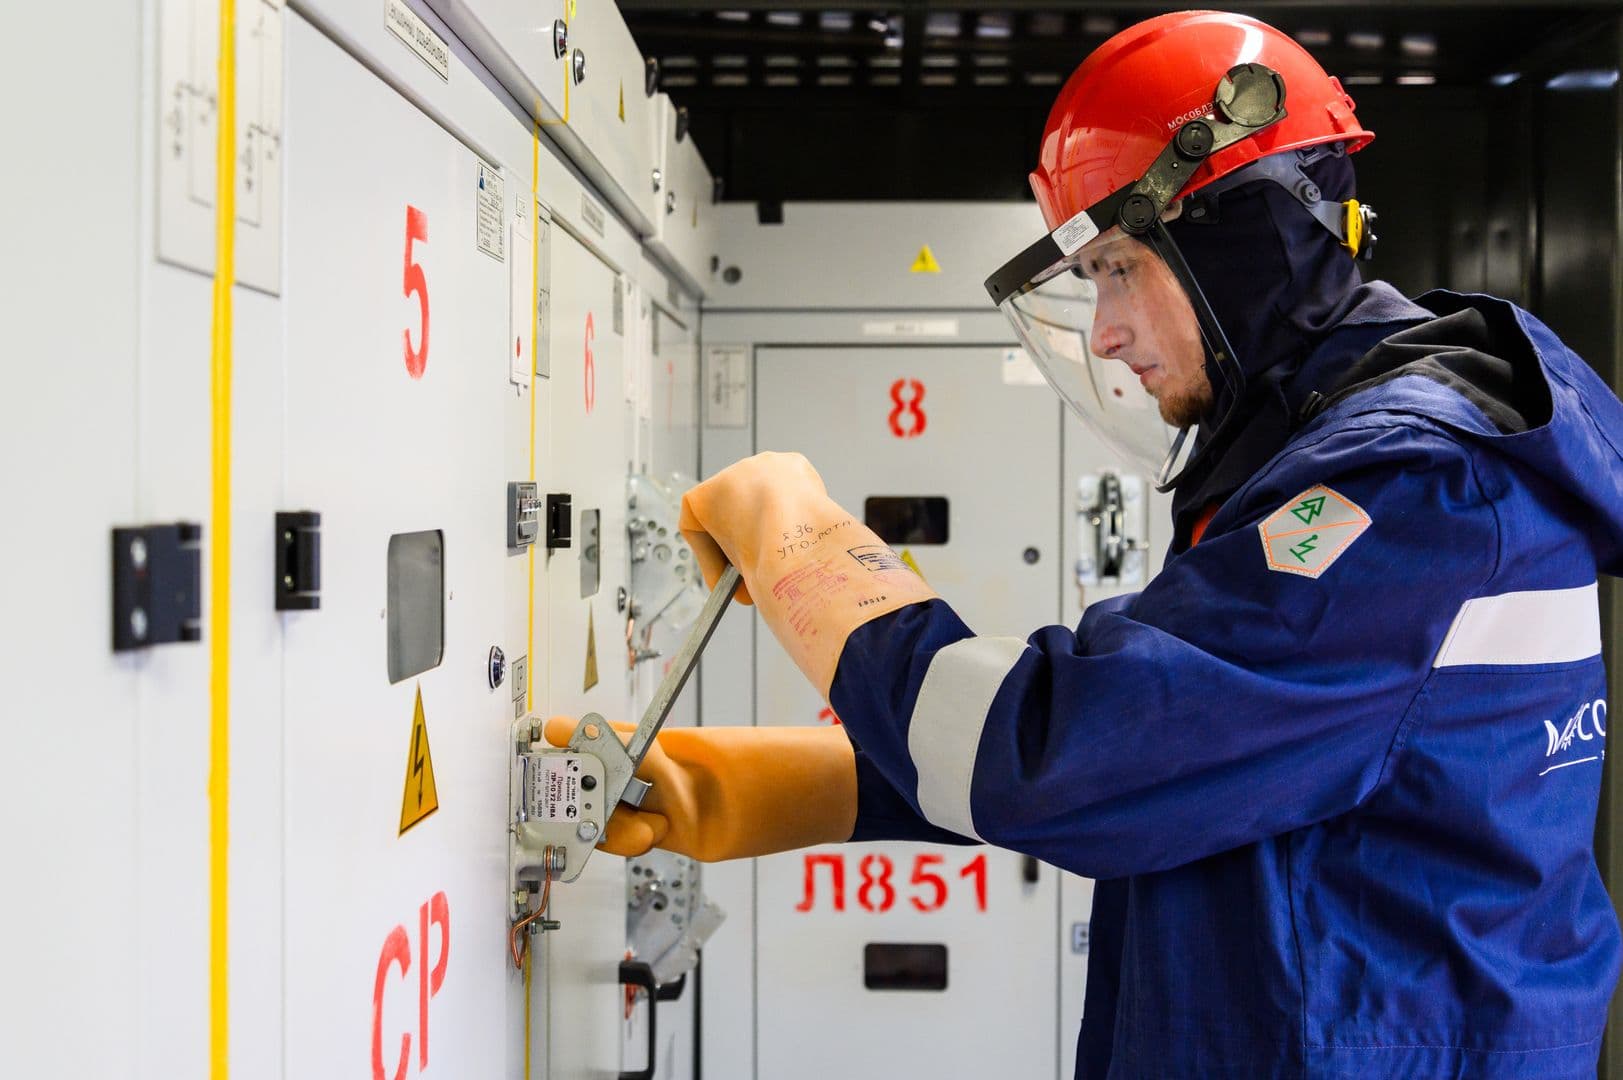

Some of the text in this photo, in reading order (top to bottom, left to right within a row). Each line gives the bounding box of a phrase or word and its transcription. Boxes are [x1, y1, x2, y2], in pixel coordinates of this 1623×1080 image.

[403, 204, 430, 381] 5
[584, 310, 595, 415] 6
[888, 378, 927, 438] 8
[556, 776, 564, 802] Привод
[794, 852, 988, 914] Л851
[371, 890, 451, 1080] СР
